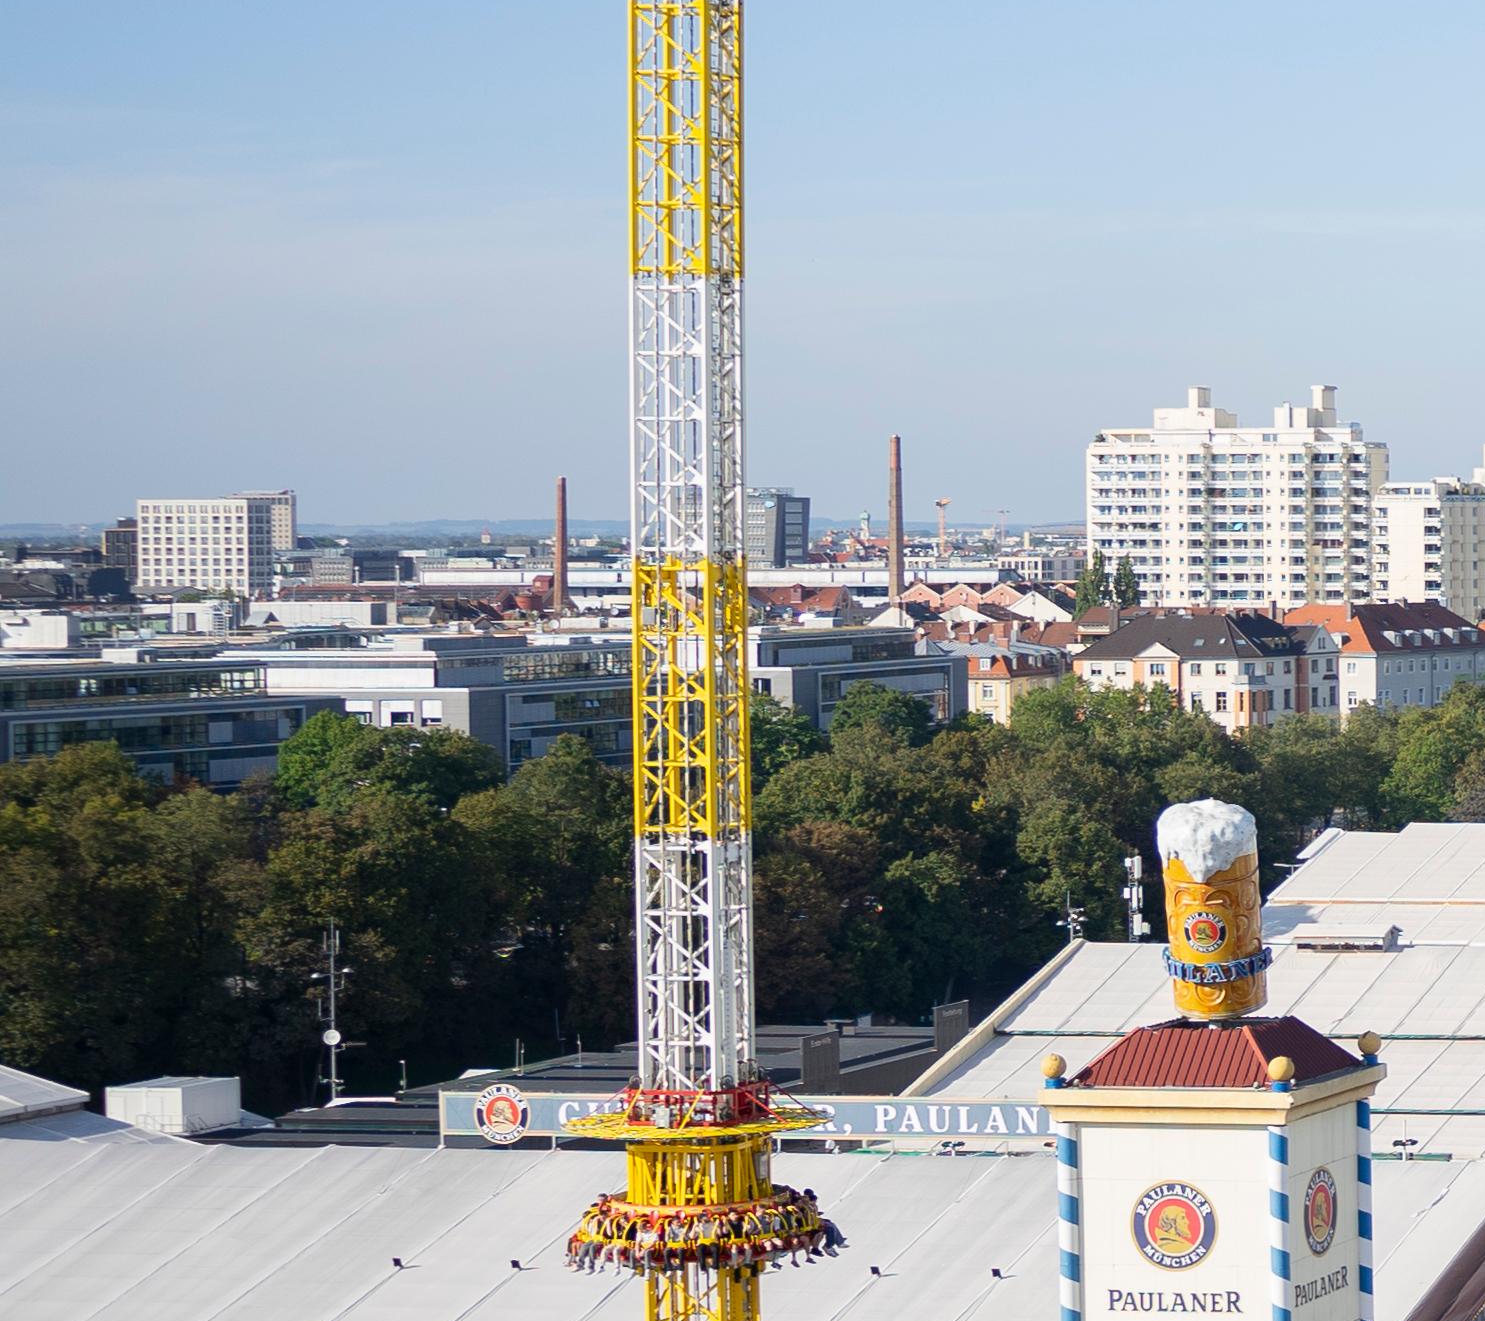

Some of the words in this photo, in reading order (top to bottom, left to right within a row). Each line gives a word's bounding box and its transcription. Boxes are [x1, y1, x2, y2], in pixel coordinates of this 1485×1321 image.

[1136, 1183, 1211, 1217] PAULANER
[1143, 1244, 1207, 1268] MÜNCHEN
[1108, 1288, 1243, 1314] PAULANER
[1294, 1266, 1349, 1309] PAULANER
